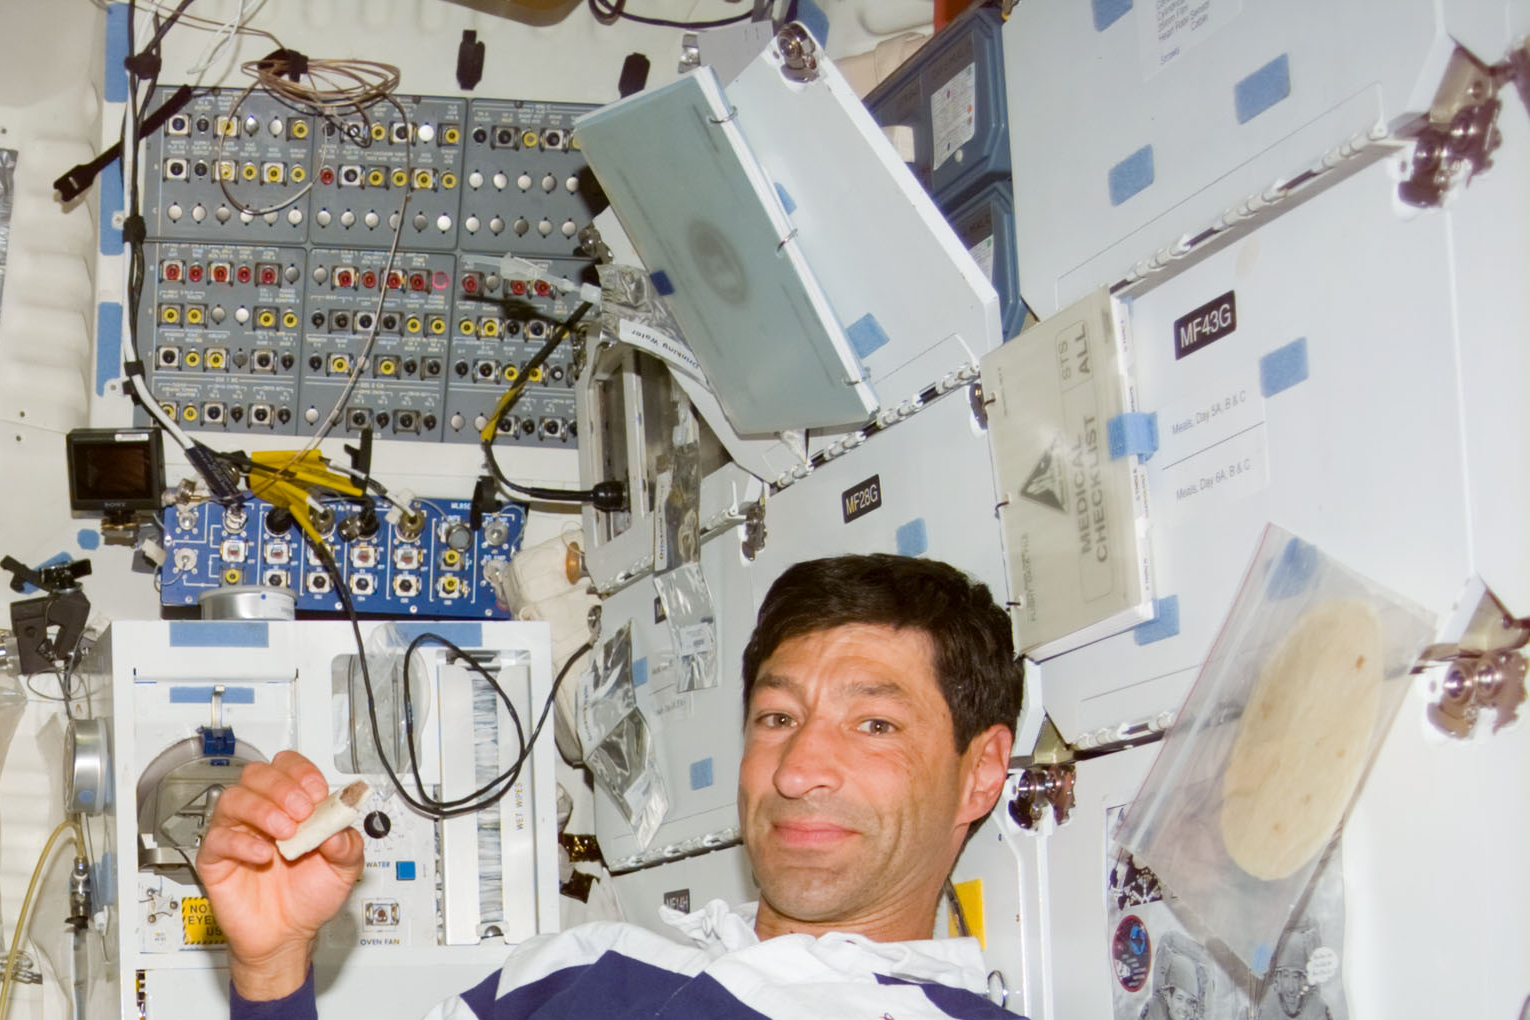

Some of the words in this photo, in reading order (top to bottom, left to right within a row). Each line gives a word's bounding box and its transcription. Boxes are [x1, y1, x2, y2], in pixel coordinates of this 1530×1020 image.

[630, 328, 660, 347] Water
[1180, 303, 1232, 347] MF43G
[659, 342, 702, 370] Drinking
[1057, 340, 1071, 381] STS
[1073, 323, 1091, 376] ALL
[1195, 406, 1209, 427] Day
[1239, 388, 1246, 404] C
[1086, 415, 1109, 563] CHECKLIST
[1199, 473, 1213, 493] Day
[1243, 456, 1251, 471] C
[845, 484, 879, 516] MF28G
[1072, 433, 1094, 555] MEDICAL
[516, 812, 524, 831] WET
[360, 938, 383, 946] OVEN
[384, 938, 401, 946] FAN
